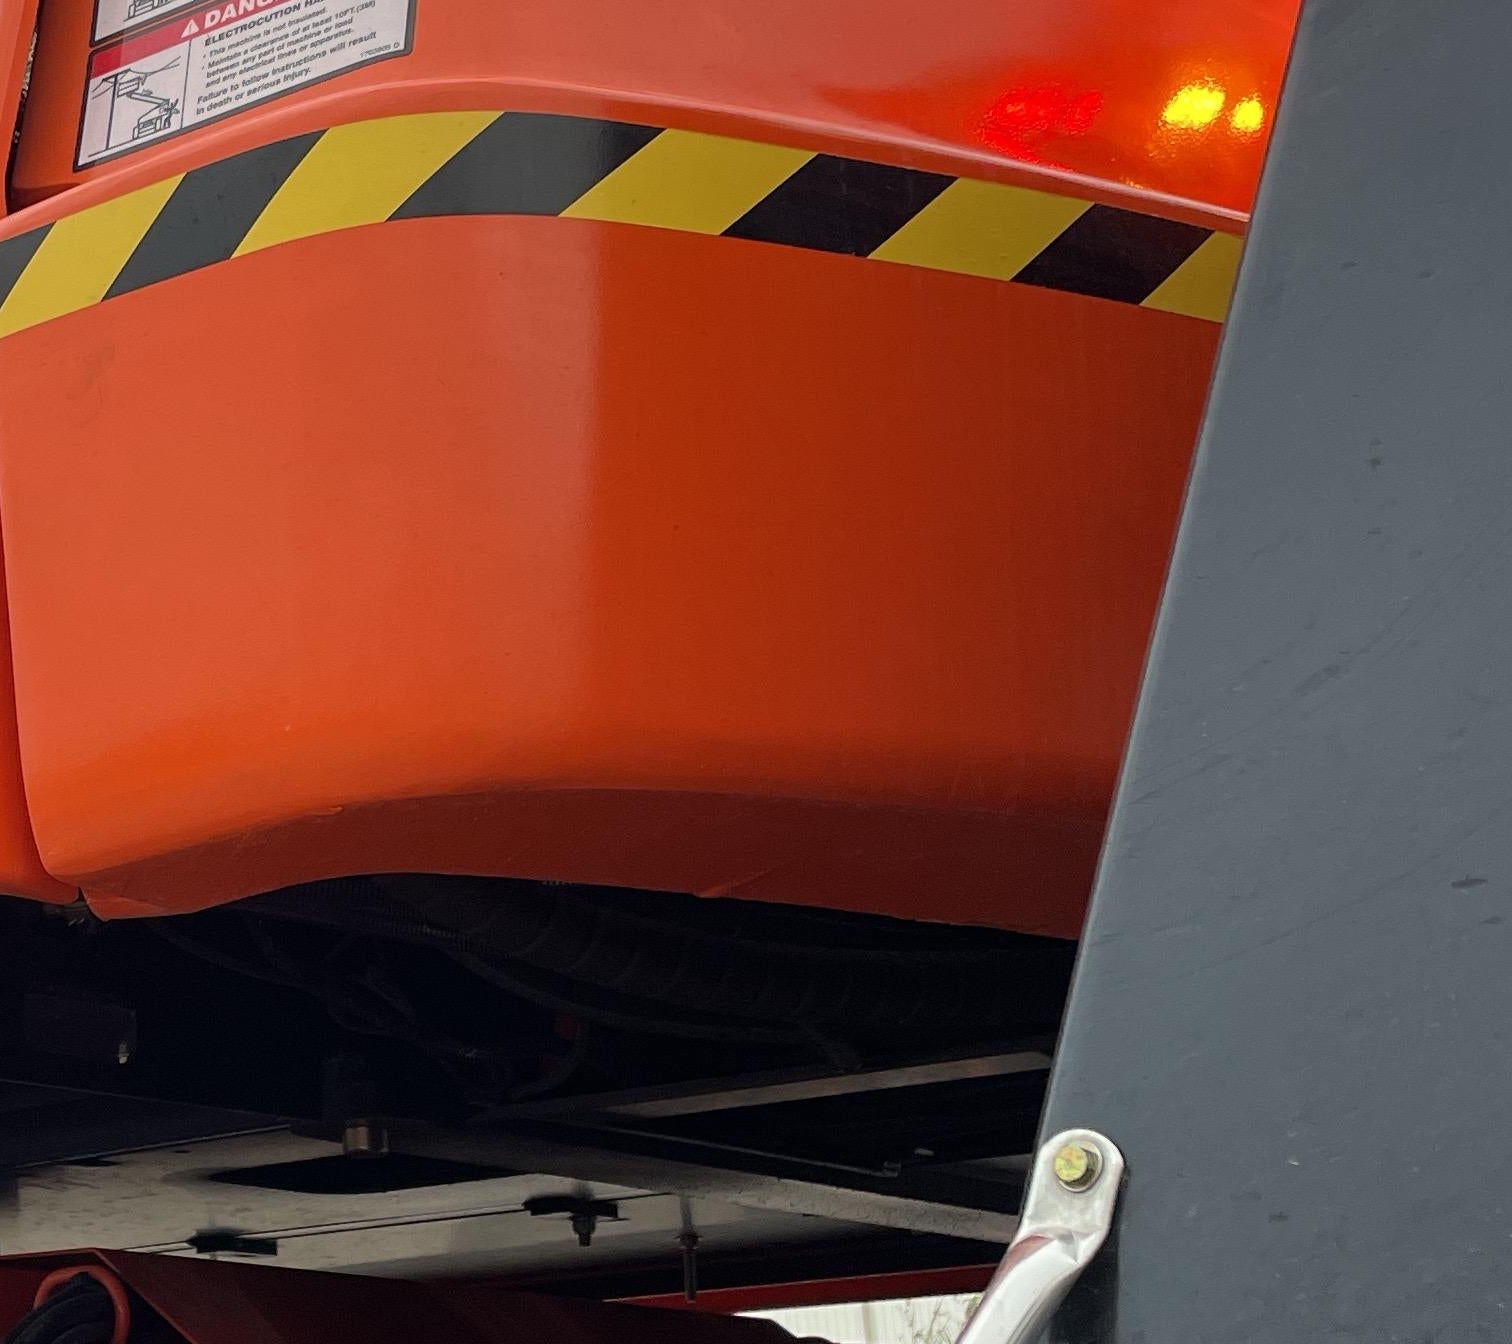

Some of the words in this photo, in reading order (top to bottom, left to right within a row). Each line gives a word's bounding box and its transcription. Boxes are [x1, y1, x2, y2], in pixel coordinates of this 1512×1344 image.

[205, 3, 300, 46] ELECTROCUTION
[197, 87, 227, 104] Failure
[230, 82, 238, 91] to
[242, 71, 269, 87] follow
[272, 49, 326, 75] instructions
[329, 41, 345, 53] will
[348, 31, 376, 46] result
[206, 95, 231, 111] death
[234, 92, 243, 100] or
[247, 78, 280, 96] serious
